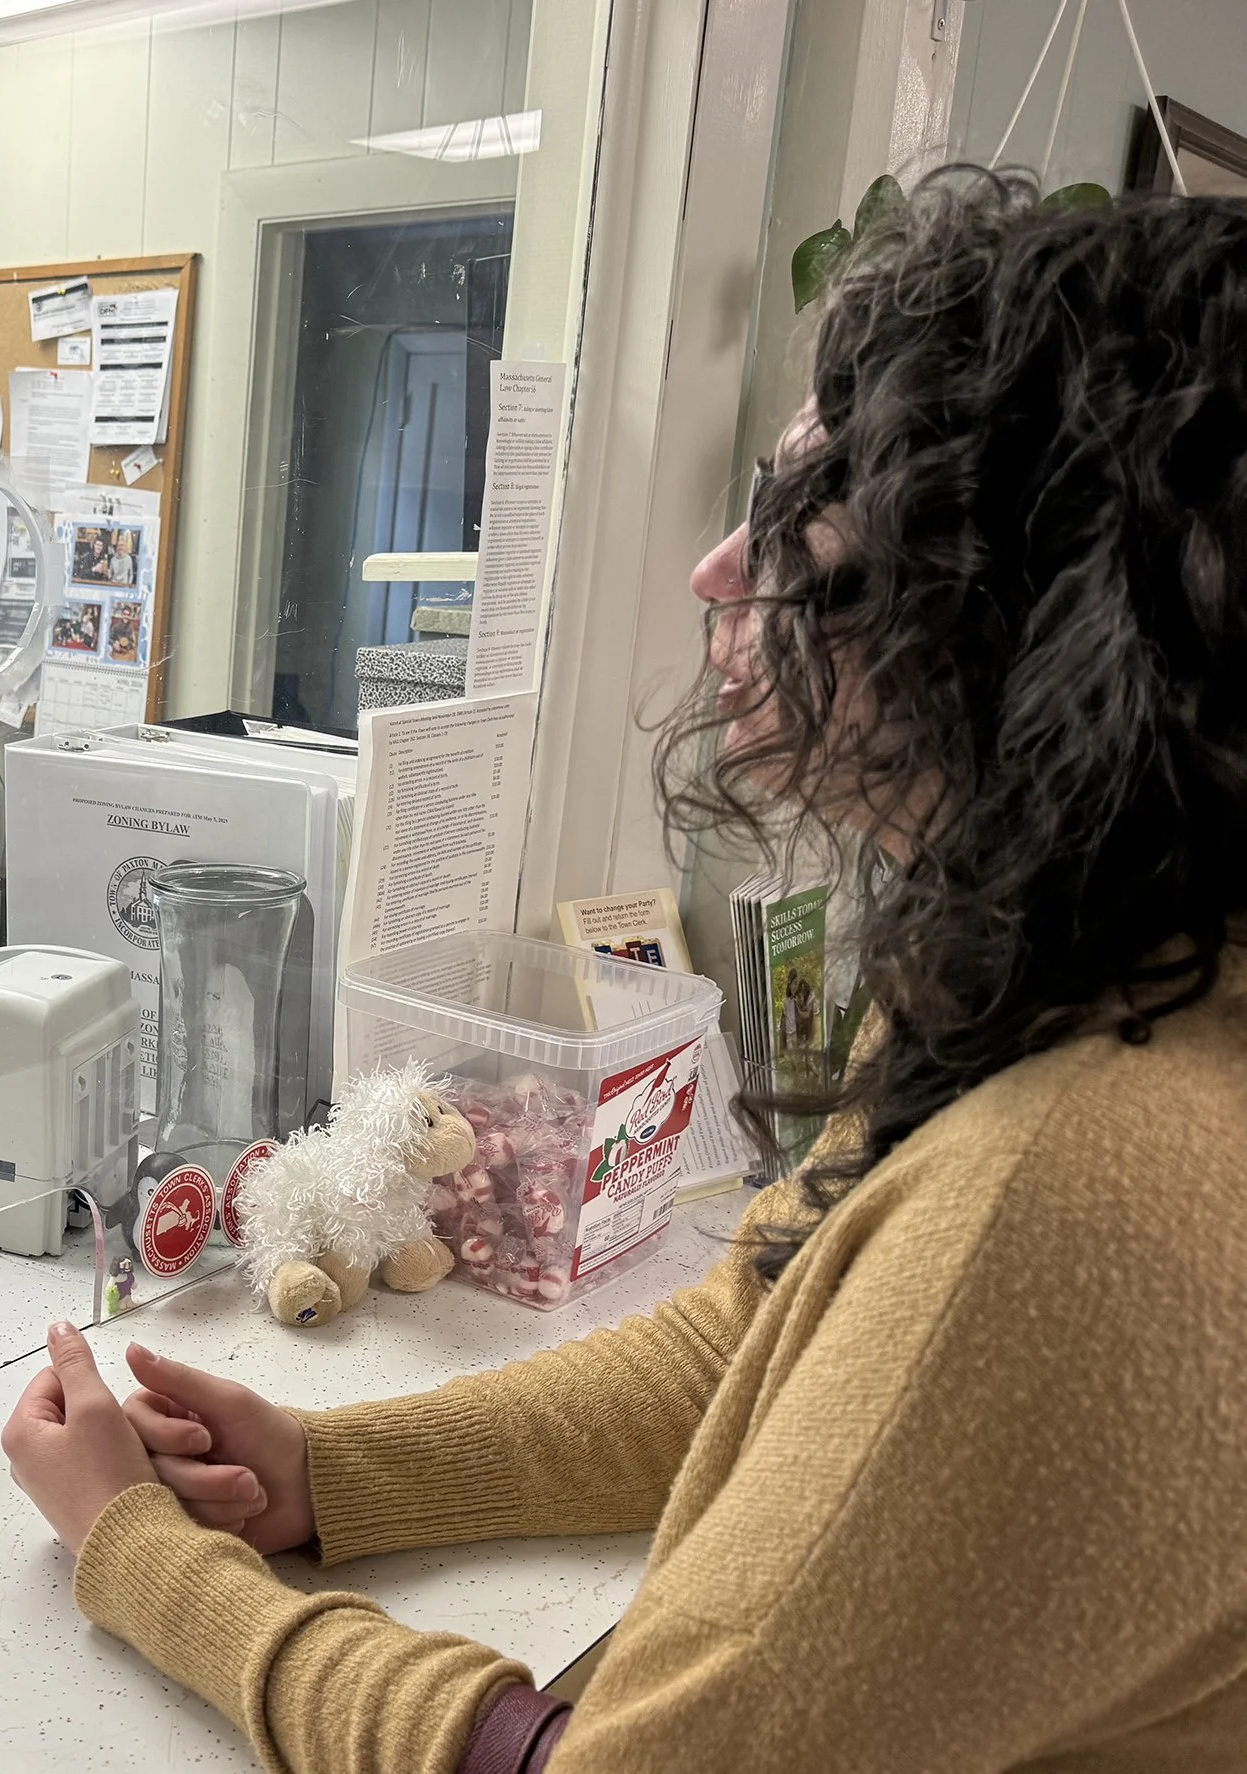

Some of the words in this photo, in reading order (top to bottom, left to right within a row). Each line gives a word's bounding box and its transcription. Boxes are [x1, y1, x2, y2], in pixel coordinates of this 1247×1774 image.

[500, 373, 534, 381] Massachusetts
[498, 403, 518, 411] Section
[107, 814, 149, 829] ZONING
[151, 820, 191, 834] BYLAW
[155, 809, 180, 817] PREPARED
[109, 884, 117, 906] TOWN
[114, 871, 122, 881] OF
[122, 859, 149, 872] PAXTON
[580, 908, 596, 916] Want
[604, 904, 624, 913] change
[625, 902, 638, 910] your
[638, 899, 656, 908] Party?
[583, 917, 591, 925] Fill
[592, 916, 601, 924] out
[602, 914, 612, 922] and
[613, 912, 628, 920] return
[638, 909, 650, 917] form
[770, 907, 797, 929] SKILLS
[114, 918, 160, 948] INCORPORATE
[585, 926, 601, 934] below
[633, 919, 647, 927] Clerk.
[771, 920, 803, 943] SUCCESS
[142, 1009, 157, 1019] OF
[601, 1135, 681, 1191] PEPPERMINT
[159, 1175, 181, 1198] TOWN
[226, 1148, 261, 1208] ASSOCATION
[607, 1168, 646, 1198] CANDY
[646, 1152, 673, 1180] PUFFS
[613, 1184, 641, 1203] NATURALLY
[641, 1169, 666, 1189] FLAVORED
[145, 1201, 177, 1271] MASSACHUSETTS
[184, 1195, 212, 1264] ASSOCIATION
